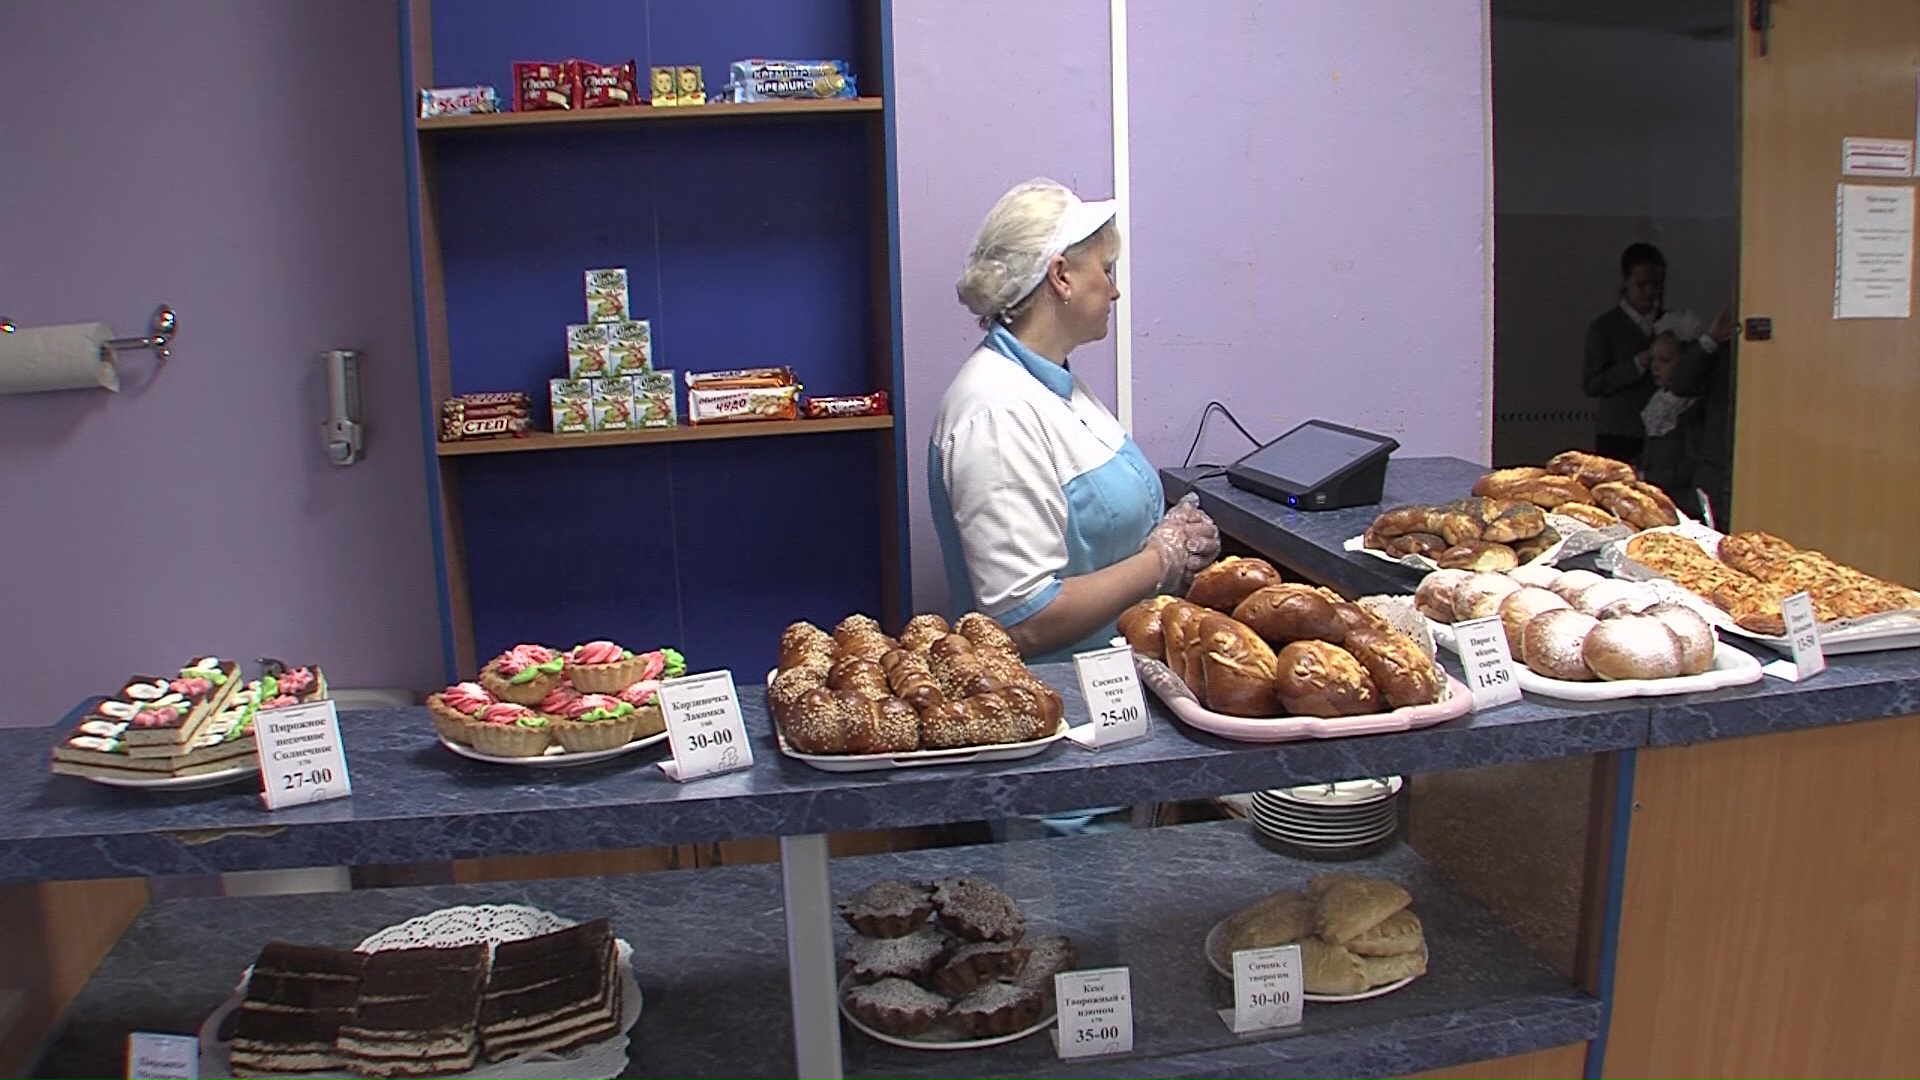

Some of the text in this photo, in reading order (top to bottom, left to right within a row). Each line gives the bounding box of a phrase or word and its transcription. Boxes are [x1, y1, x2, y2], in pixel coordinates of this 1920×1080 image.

[716, 398, 747, 412] ЧУДО
[464, 419, 505, 433] СТЕП
[1092, 677, 1123, 688] Сосиска
[1478, 669, 1510, 688] 14-50
[1104, 688, 1124, 698] тесте
[671, 694, 730, 711] Корзиночка
[683, 708, 726, 722] Лакомка
[1100, 706, 1139, 727] 25-00
[269, 718, 327, 734] Пирожное
[275, 732, 326, 746] песочное
[687, 728, 733, 751] 30-00
[273, 745, 333, 761] Солнечное
[282, 768, 333, 790] 27-00
[1248, 962, 1281, 971] Сочень
[1248, 973, 1290, 983] творогом
[1083, 984, 1105, 994] Кекс
[1065, 994, 1119, 1007] Творожный
[1248, 991, 1291, 1009] 30-00
[1077, 1007, 1115, 1017] изюмом
[1075, 1025, 1119, 1043] 35-00
